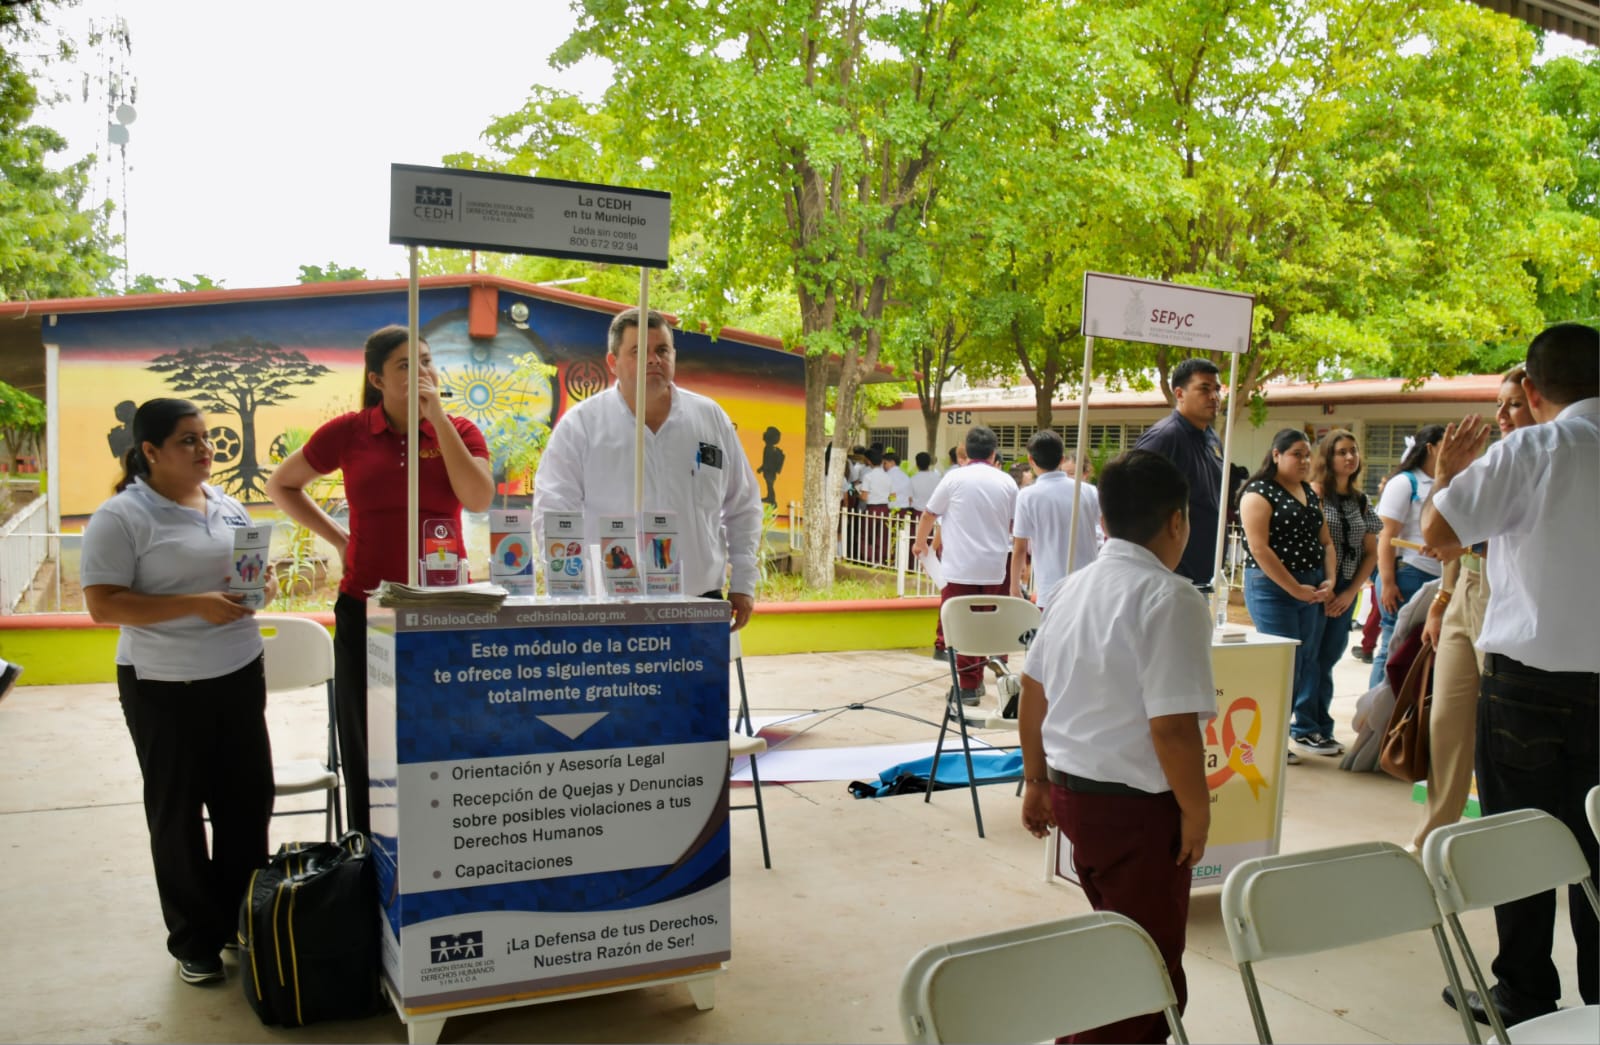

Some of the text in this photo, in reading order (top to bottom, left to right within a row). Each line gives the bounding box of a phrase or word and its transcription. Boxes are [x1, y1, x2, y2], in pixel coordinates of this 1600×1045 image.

[578, 195, 632, 211] La CEDH
[413, 206, 454, 220] CEDH
[564, 209, 647, 226] en tu Municipio
[573, 224, 637, 240] Lada sin costo
[570, 237, 639, 251] 800 672 92 94
[1150, 308, 1195, 329] SEPyC
[947, 411, 972, 425] SEC
[422, 612, 497, 626] SinaloaCedh
[516, 610, 626, 623] cedhsinaloa.org.mx
[657, 607, 725, 619] CEDHSinaloa
[472, 636, 671, 658] Este módulo de la CEDH
[434, 658, 704, 684] te ofrece los siguientes servicios
[488, 682, 662, 704] totalmente gratuitos:
[452, 751, 665, 780] Orientación y Asesoría Legal
[453, 774, 704, 807] Recepción de Quejas y Denuncias
[452, 796, 692, 829] sobre posibles violaciones a tus
[454, 825, 604, 850] Derechos Humanos
[455, 856, 573, 879] Capacitaciones
[506, 913, 718, 955] ¡La Defensa de tus Derechos,
[533, 933, 695, 969] Nuestra Razón de Ser!
[421, 971, 458, 982] DERECHOS
[440, 976, 477, 986] SINALOA
